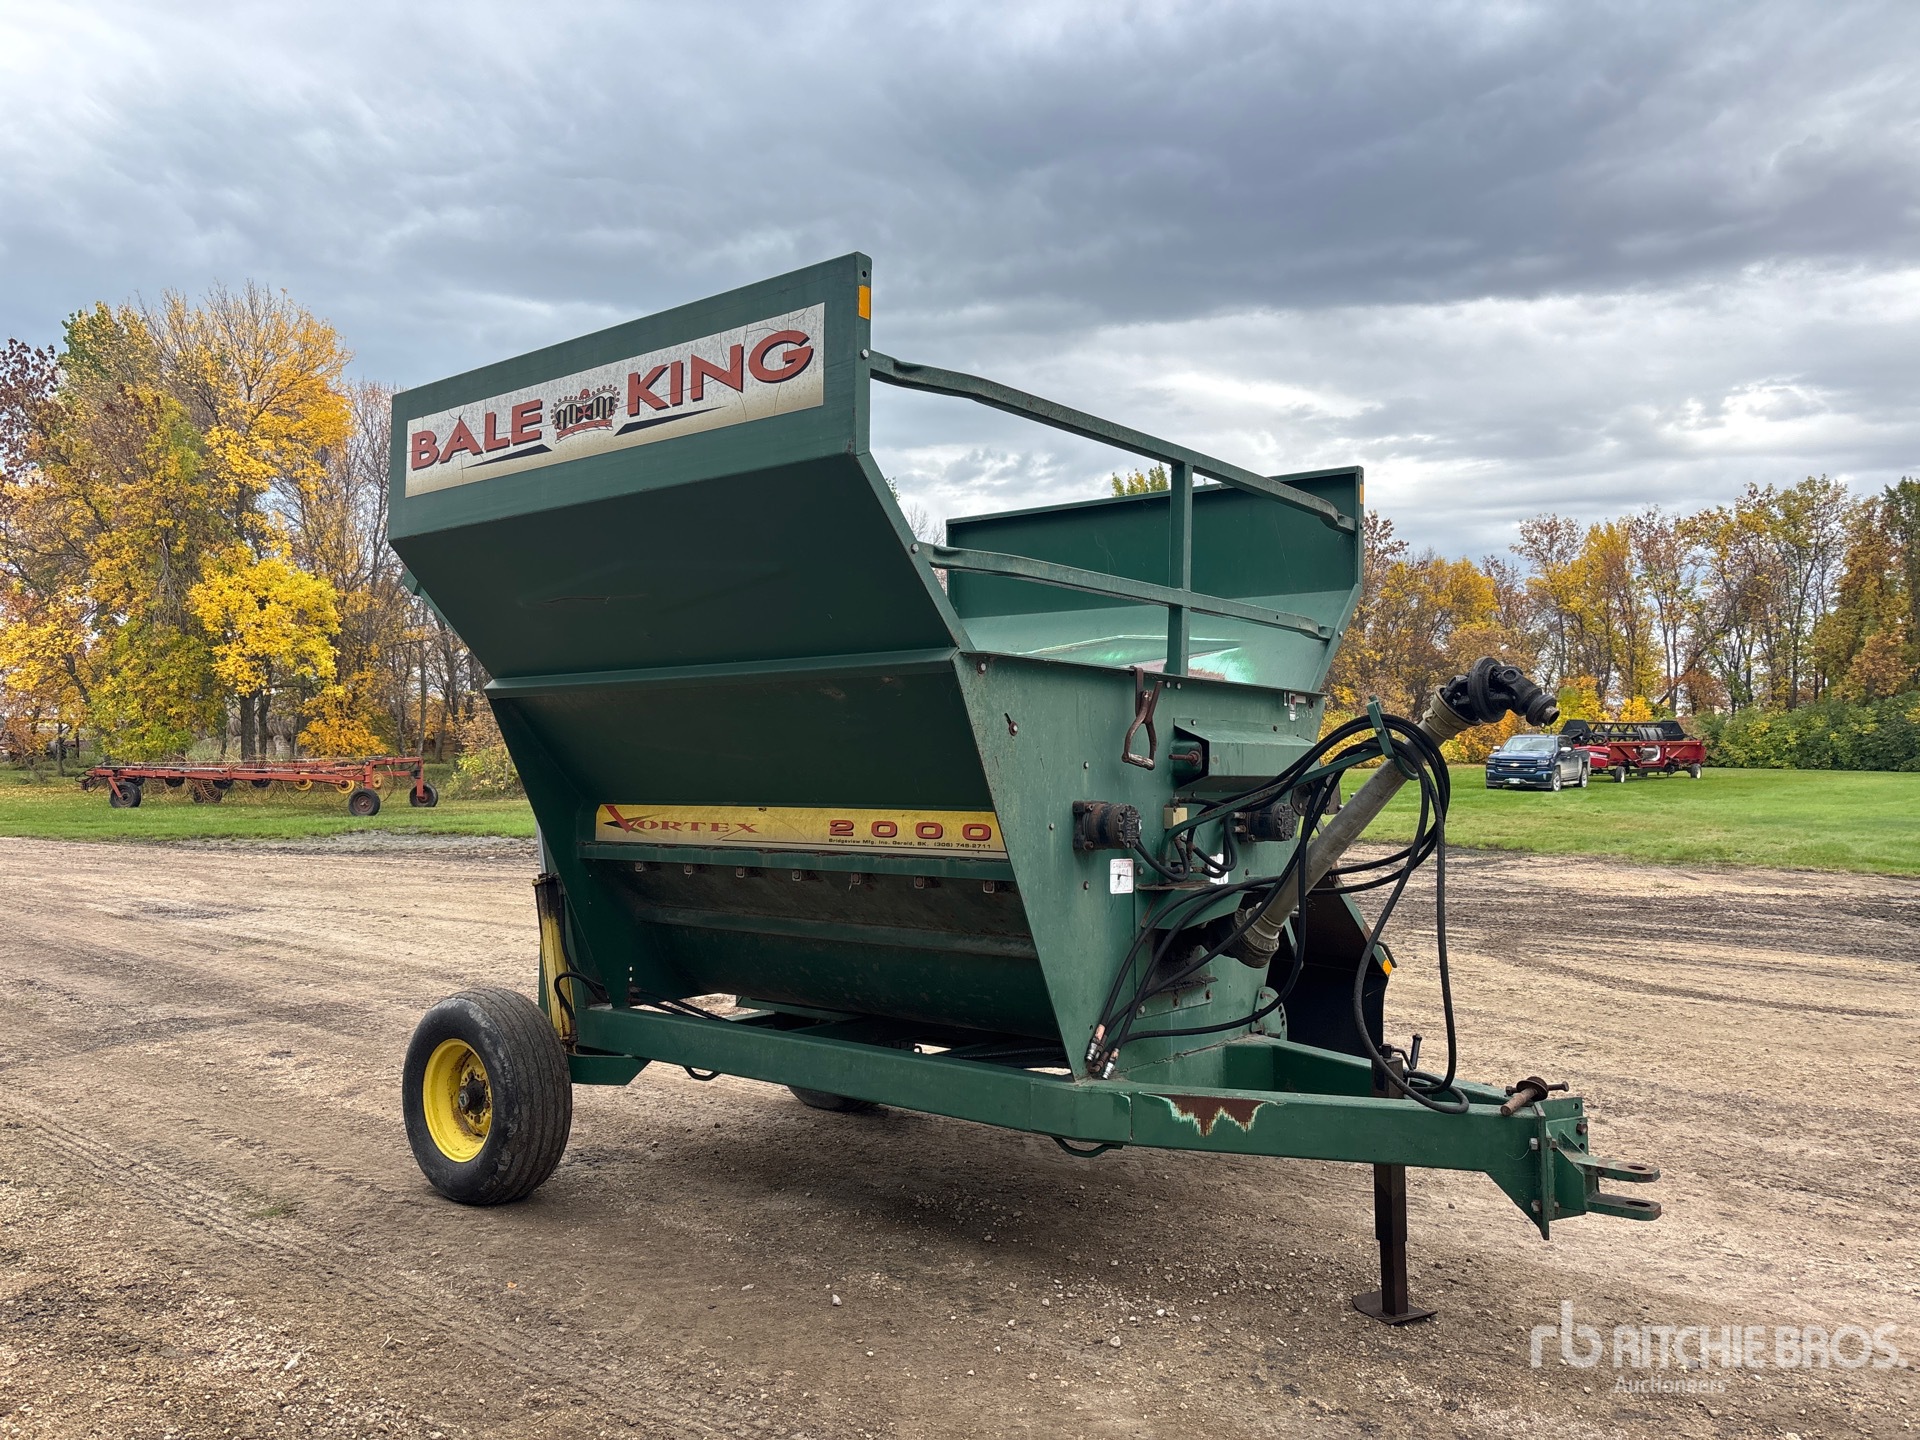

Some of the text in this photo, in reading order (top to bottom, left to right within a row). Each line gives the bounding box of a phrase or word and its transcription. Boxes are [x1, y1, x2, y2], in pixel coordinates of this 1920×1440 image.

[412, 330, 814, 471] BALE KING
[829, 820, 992, 841] 2000
